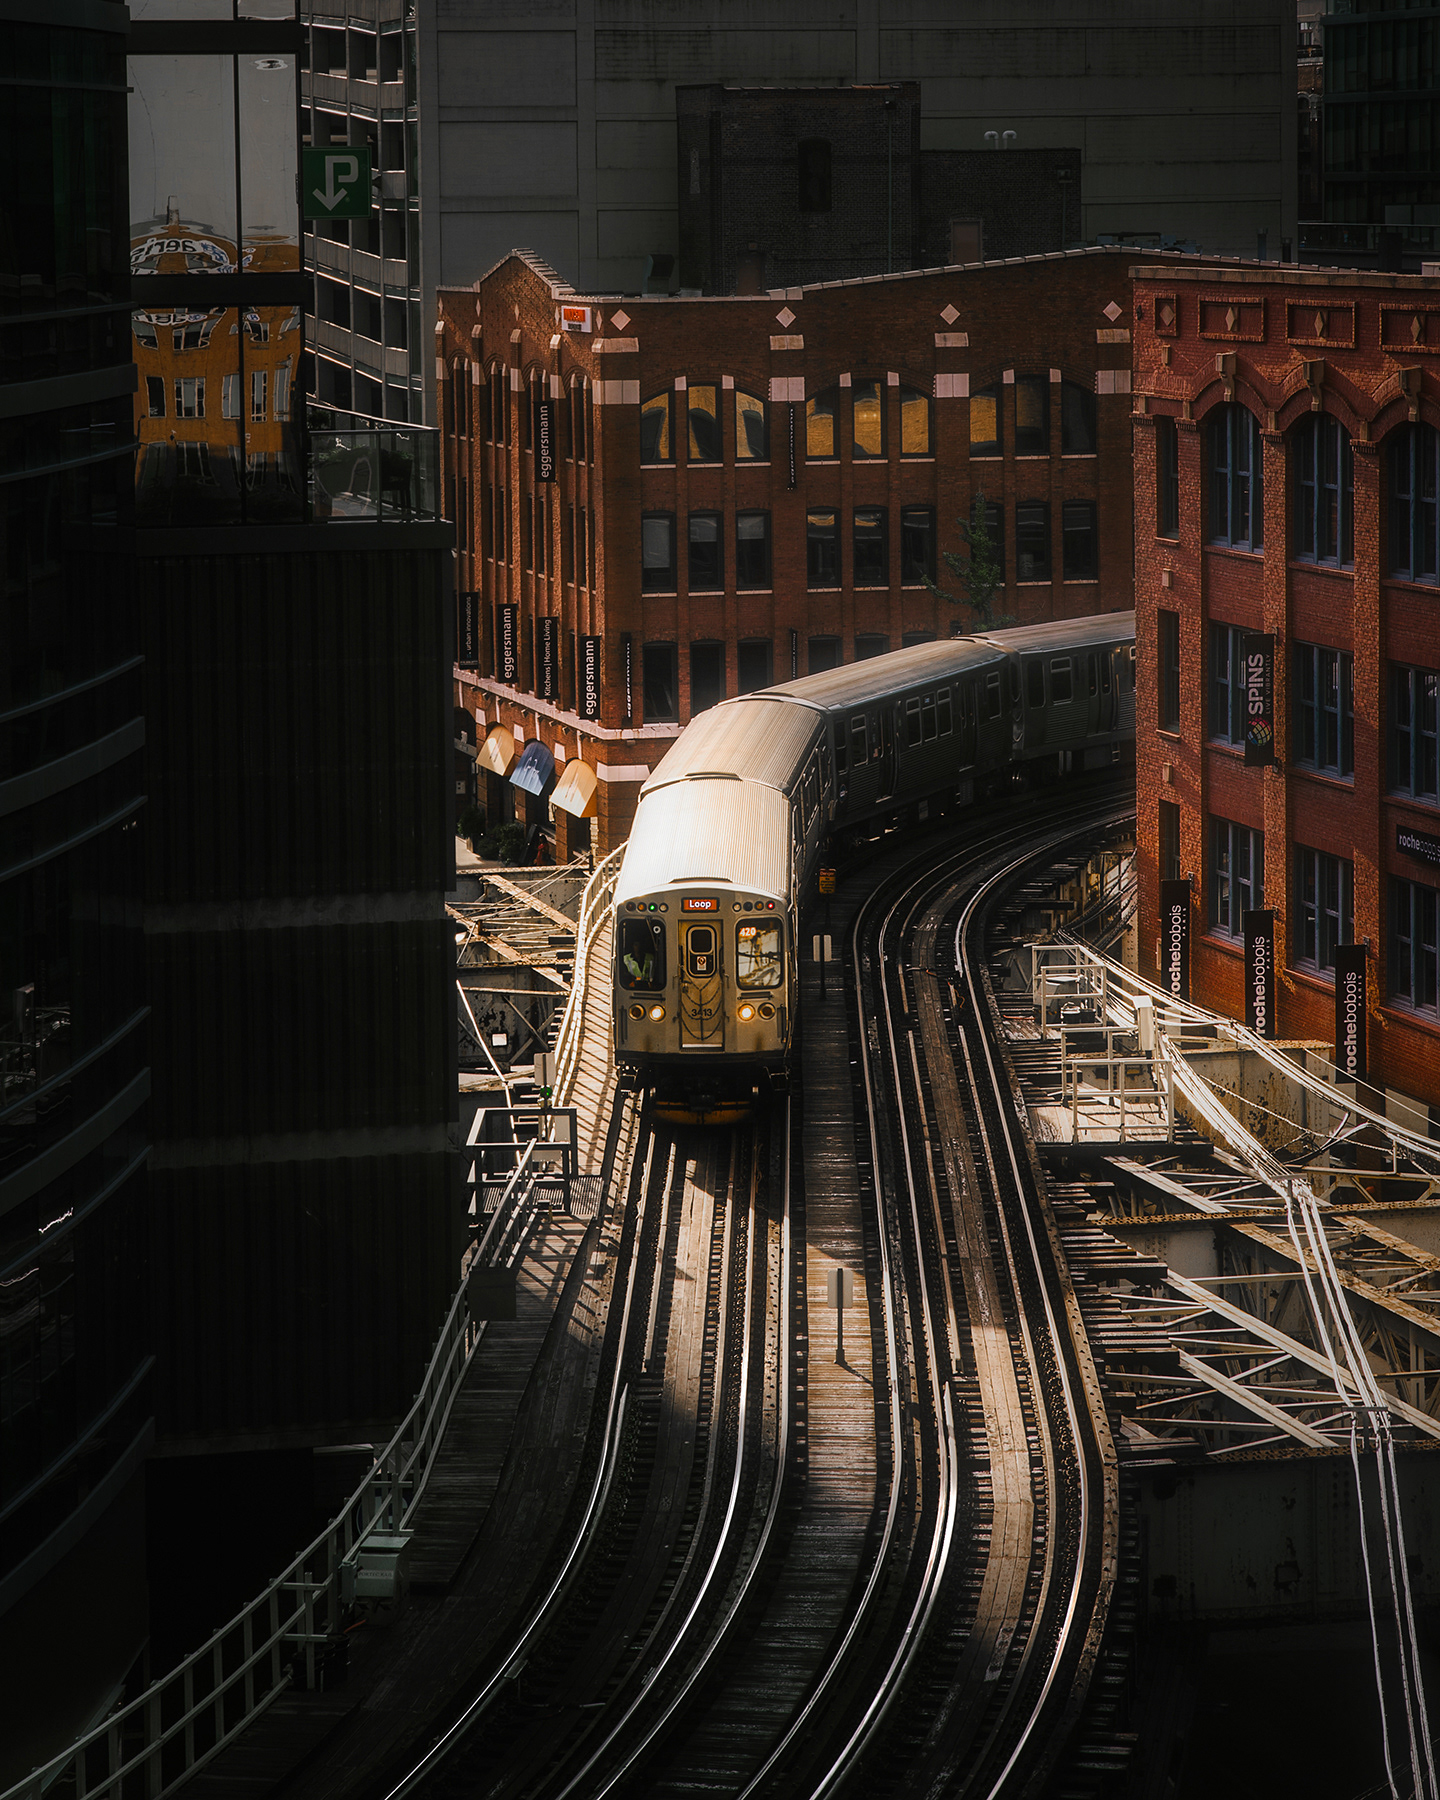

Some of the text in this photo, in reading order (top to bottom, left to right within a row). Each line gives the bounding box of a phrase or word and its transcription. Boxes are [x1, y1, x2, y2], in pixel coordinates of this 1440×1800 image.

[325, 155, 359, 211] P
[540, 405, 552, 478] eggersmann
[503, 608, 515, 679] eggersmann
[543, 619, 552, 697] Kitchens Home Living
[585, 640, 597, 715] eggersmann
[1248, 653, 1264, 715] SPINS
[689, 899, 712, 909] Loop
[739, 927, 756, 937] 420
[691, 1008, 713, 1017] 3413
[1252, 936, 1266, 1035] rochebobois
[1343, 971, 1357, 1075] rochebobois
